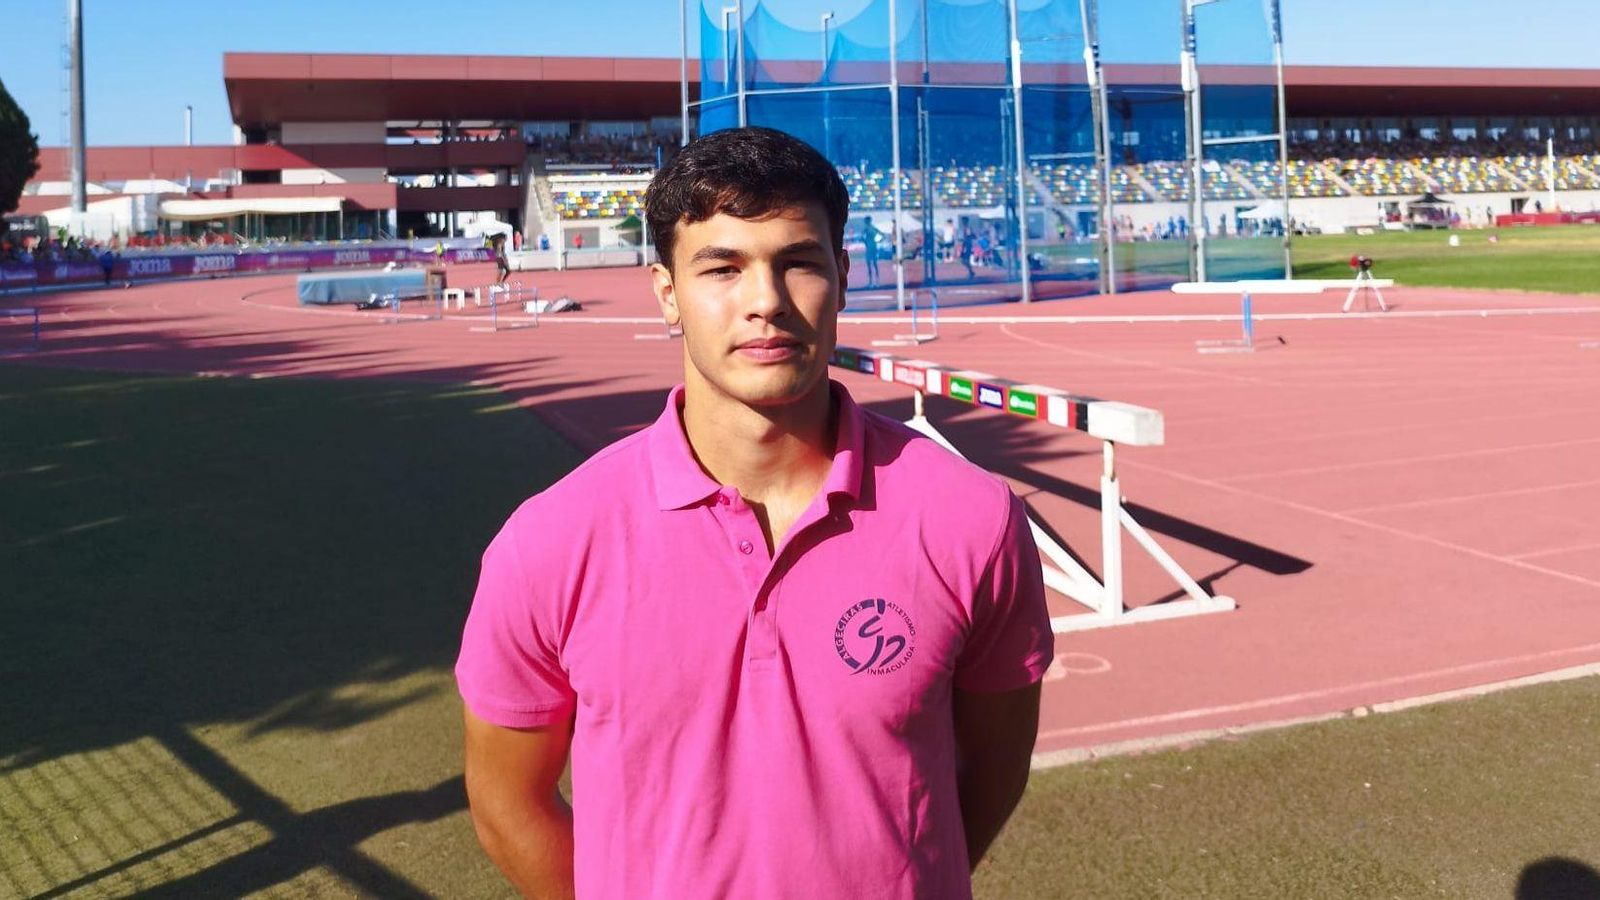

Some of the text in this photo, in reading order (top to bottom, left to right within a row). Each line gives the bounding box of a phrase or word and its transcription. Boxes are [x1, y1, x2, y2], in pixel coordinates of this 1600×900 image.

[835, 602, 863, 660] ALGECIRAS
[886, 602, 916, 636] ATLETISMO
[867, 646, 916, 675] INMACULADA
